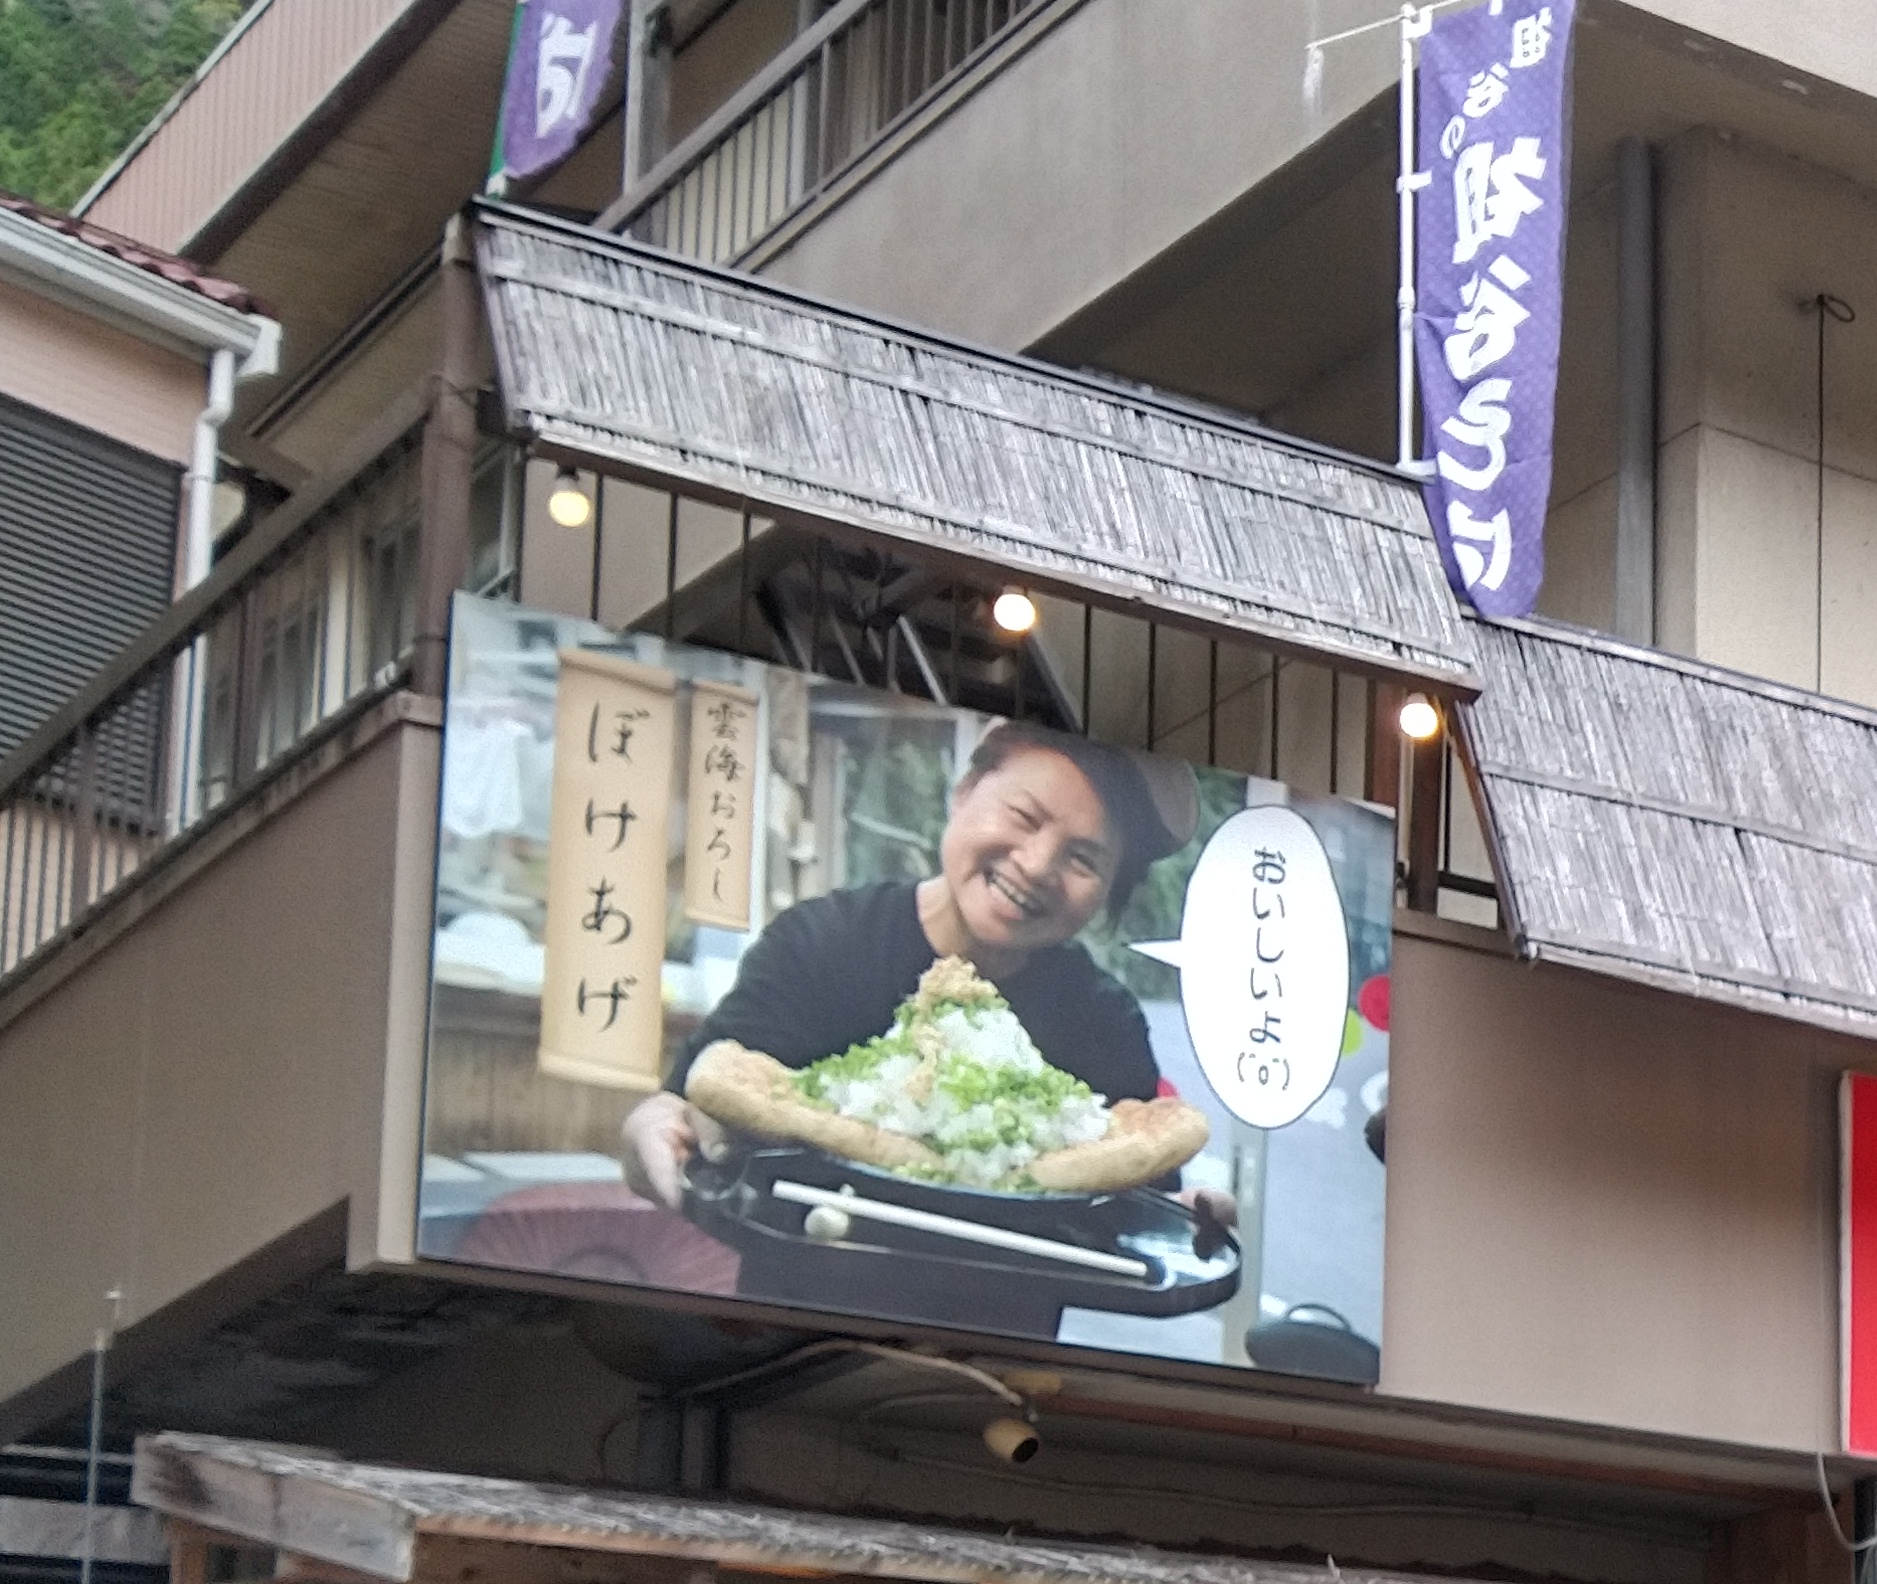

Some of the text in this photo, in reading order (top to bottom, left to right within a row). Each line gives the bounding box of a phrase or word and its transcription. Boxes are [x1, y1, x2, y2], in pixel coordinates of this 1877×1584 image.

[576, 699, 650, 1033] ぼけあげ
[704, 702, 747, 901] 雲海おろし
